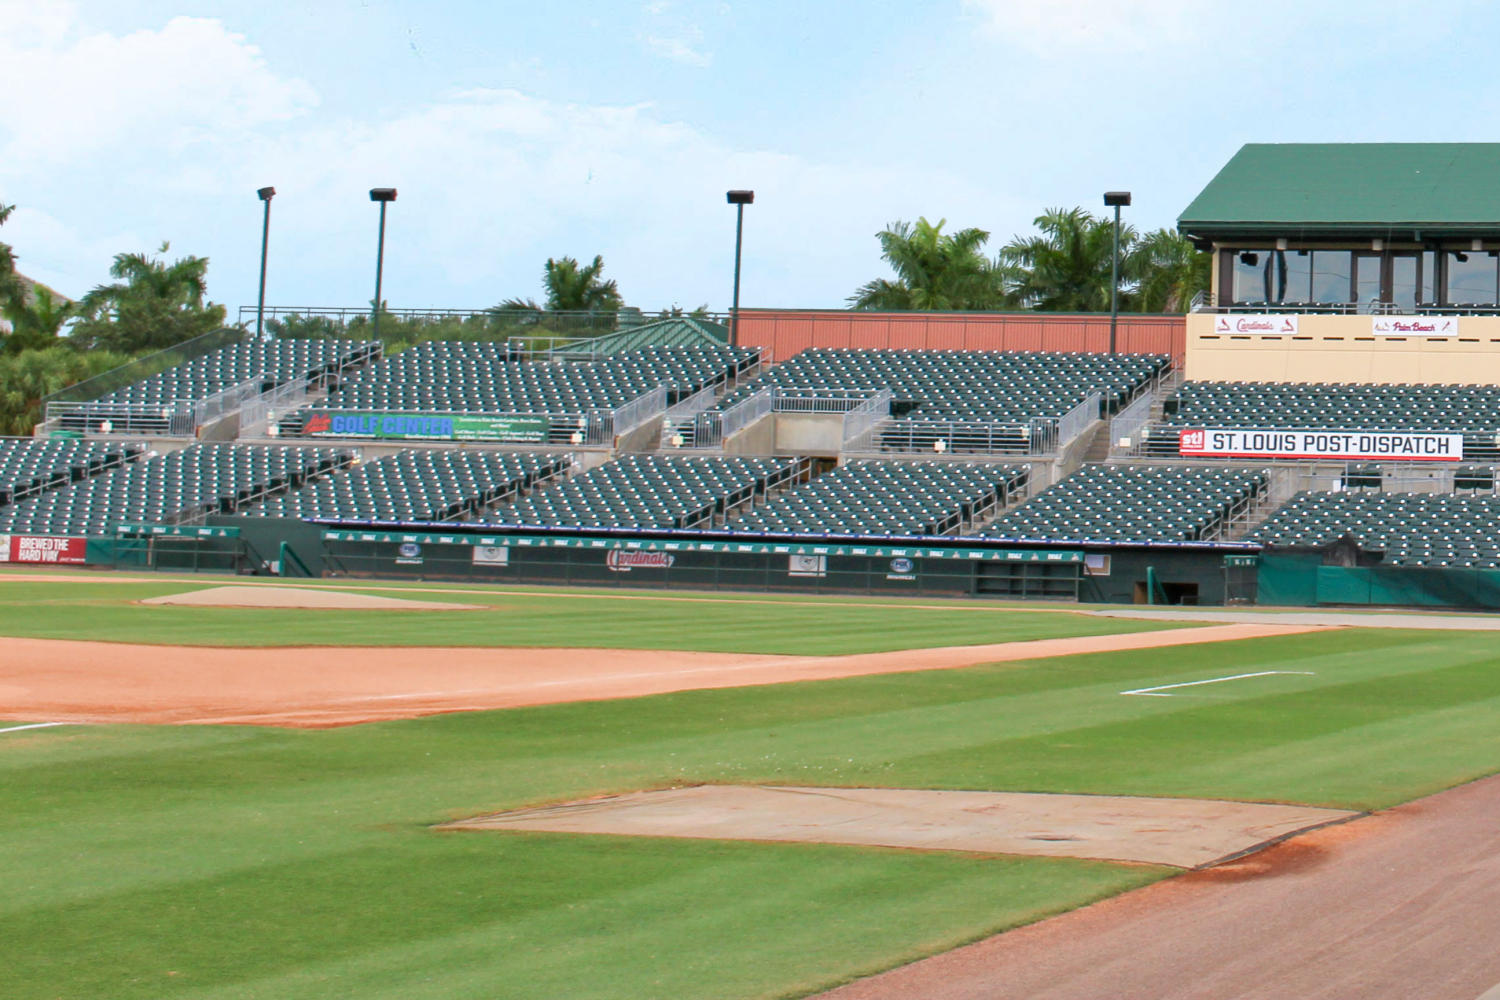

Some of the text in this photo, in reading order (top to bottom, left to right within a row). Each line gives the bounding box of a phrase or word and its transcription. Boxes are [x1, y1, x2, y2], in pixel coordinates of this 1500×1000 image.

[332, 416, 377, 433] GOLF
[382, 417, 453, 434] CENTER
[1213, 434, 1449, 454] ST. LOUIS POST-DISPATCH
[20, 537, 69, 550] BREWED THE
